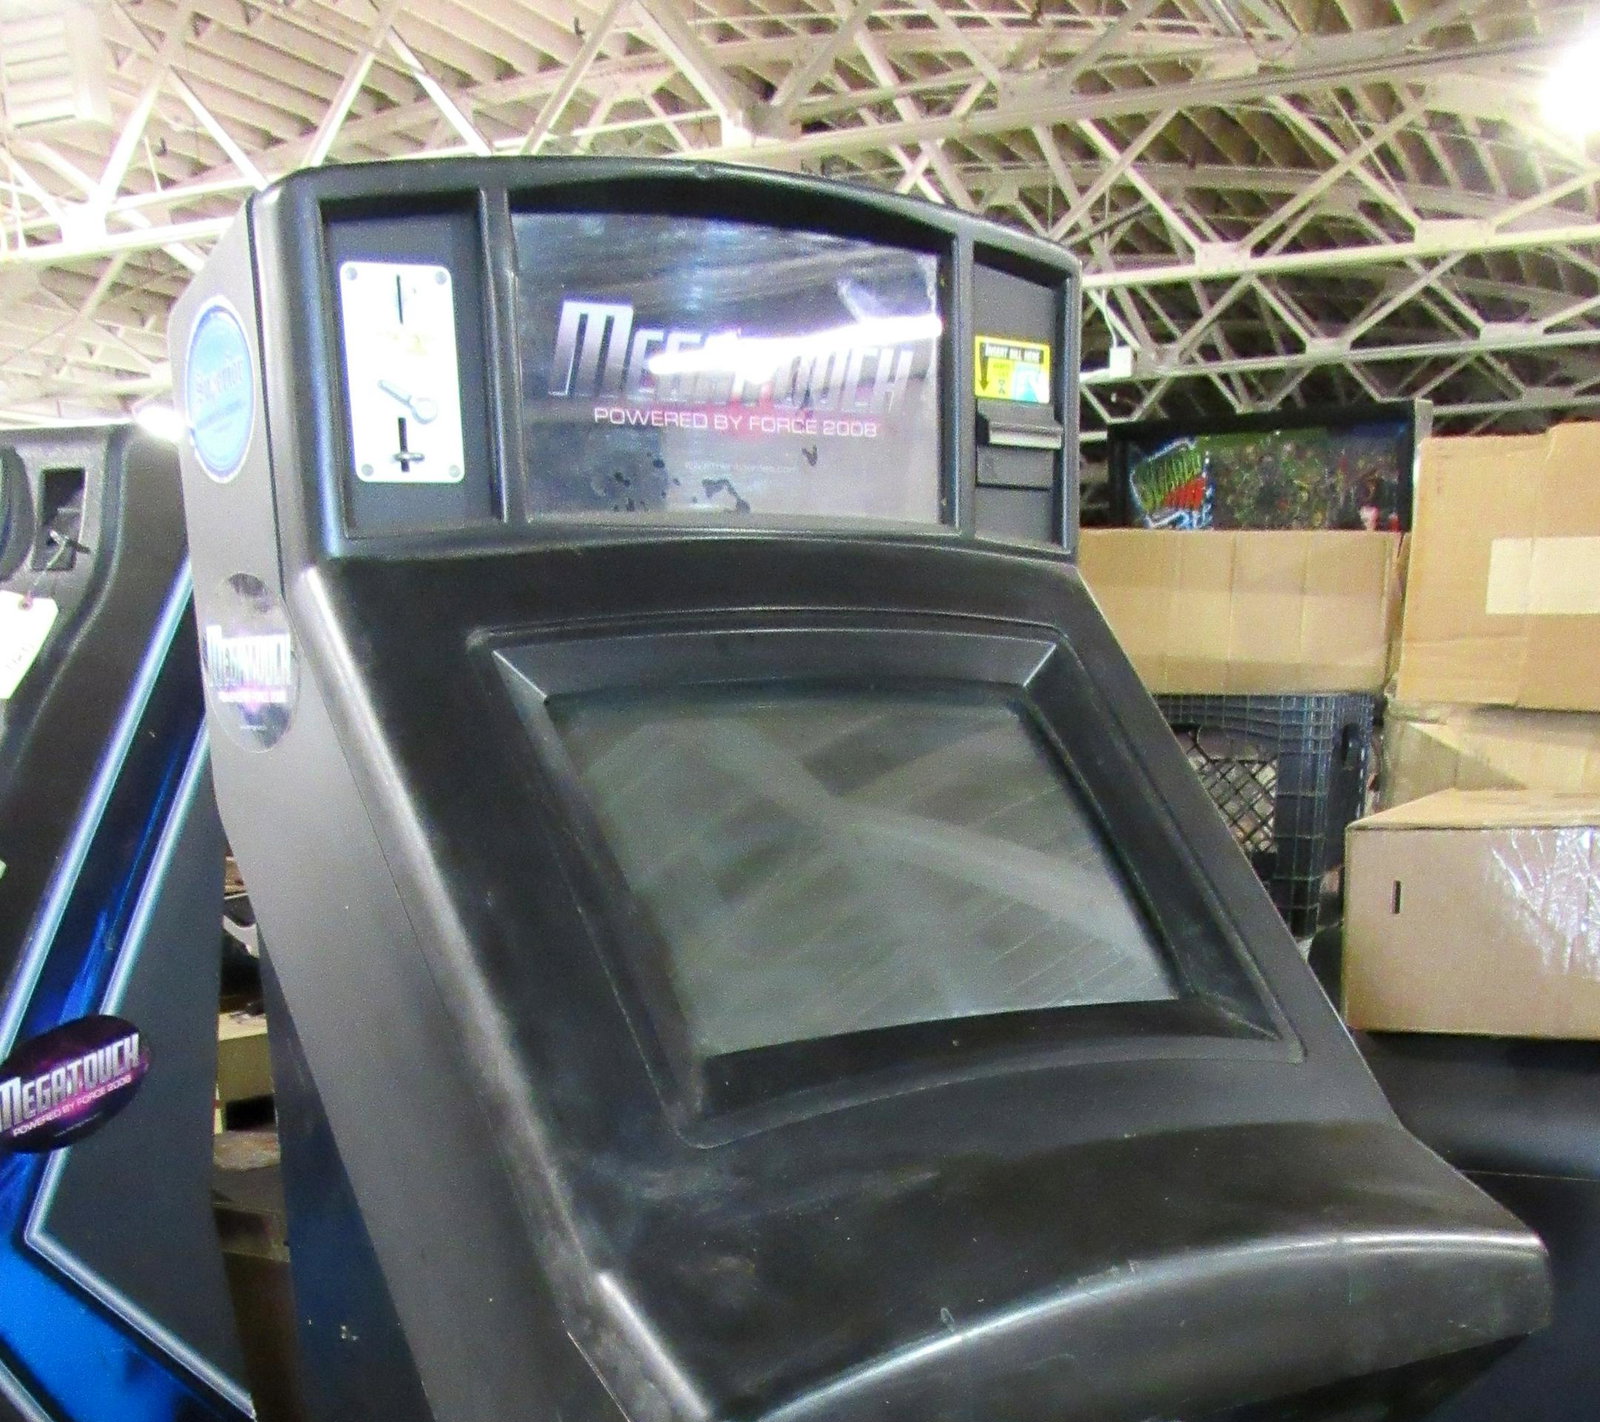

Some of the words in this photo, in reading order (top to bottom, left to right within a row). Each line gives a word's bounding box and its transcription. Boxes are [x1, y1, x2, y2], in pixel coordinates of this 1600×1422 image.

[594, 406, 708, 429] POWERED
[713, 414, 743, 430] BY
[749, 415, 818, 434] FORCE
[822, 419, 878, 438] 2008
[0, 1033, 140, 1132] MEGATOUCH
